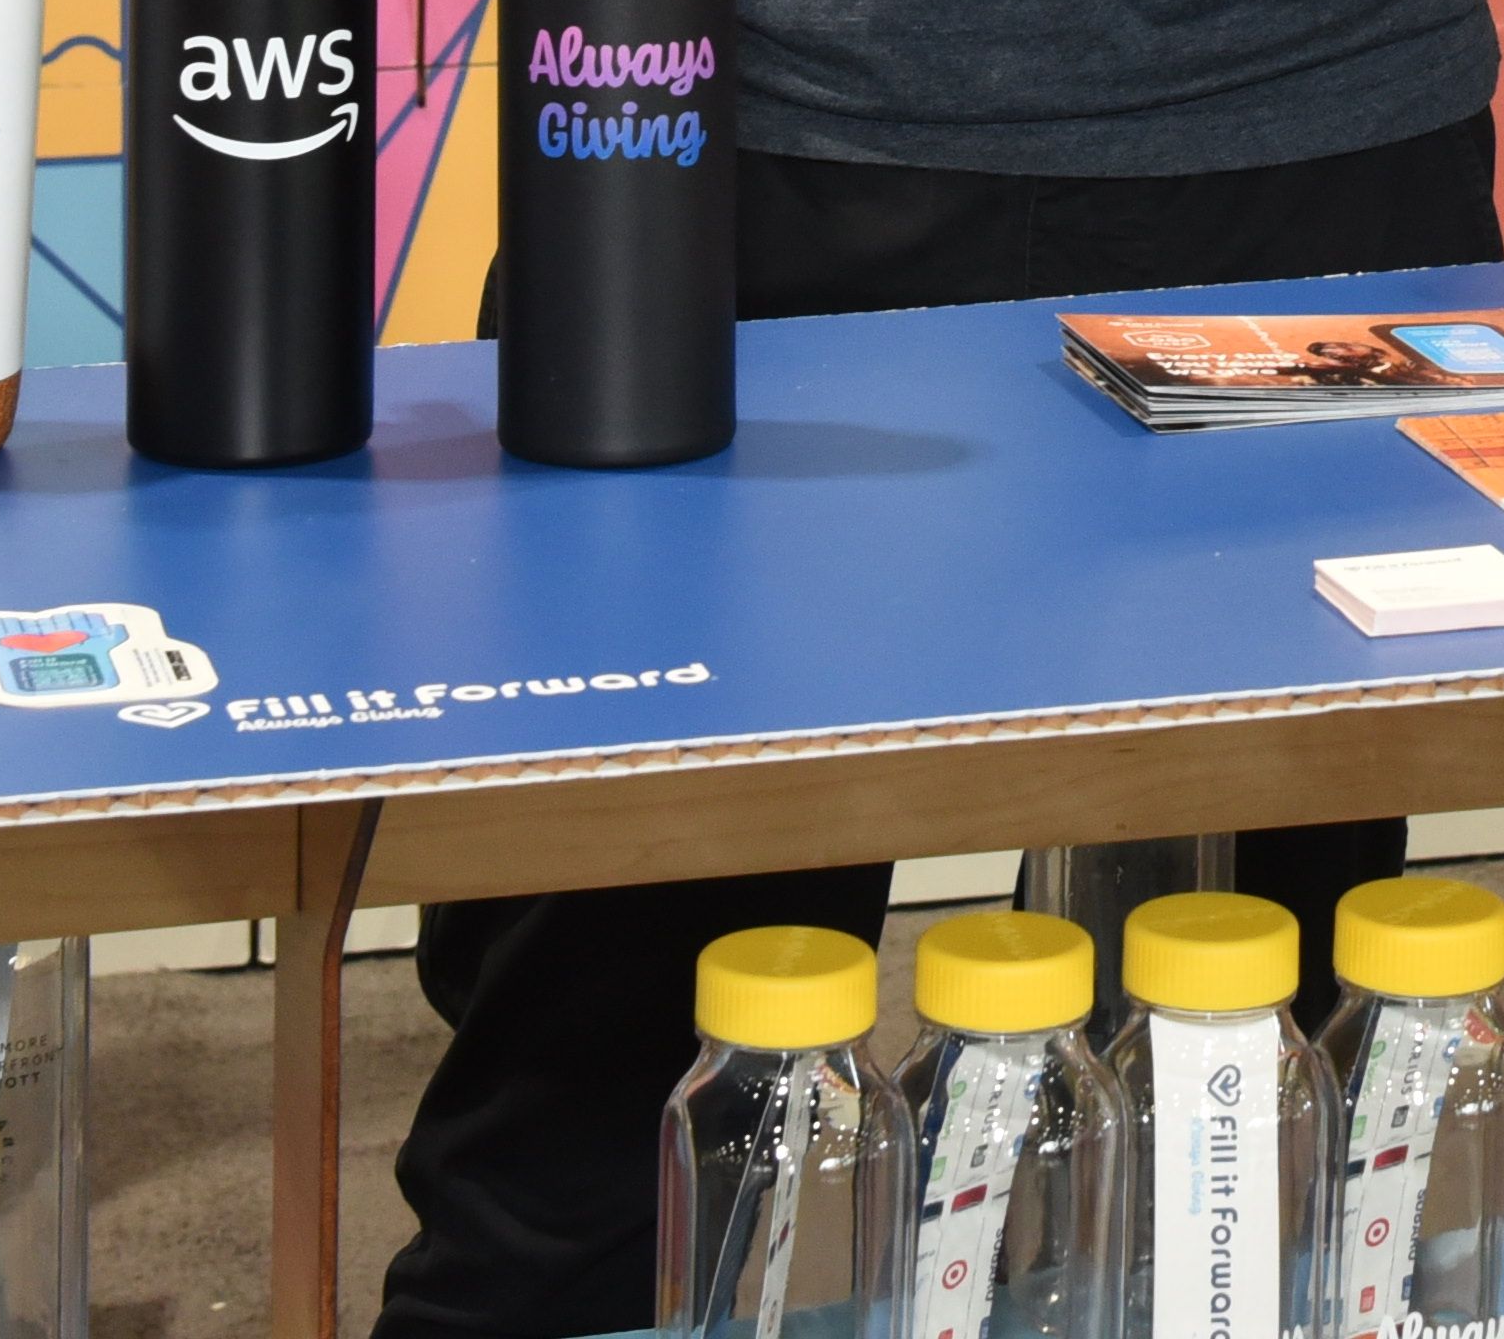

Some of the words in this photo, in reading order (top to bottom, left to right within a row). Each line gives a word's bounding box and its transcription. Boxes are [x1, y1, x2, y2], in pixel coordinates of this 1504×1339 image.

[178, 26, 357, 102] aws
[528, 25, 716, 98] Always
[538, 98, 707, 168] Giving
[1146, 352, 1227, 364] Every
[226, 688, 332, 722] Fill
[349, 688, 396, 711] it
[416, 663, 709, 703] Forward
[236, 710, 344, 734] Always
[349, 705, 444, 725] Giving
[1210, 1114, 1239, 1164] Fill
[1210, 1174, 1239, 1198] it
